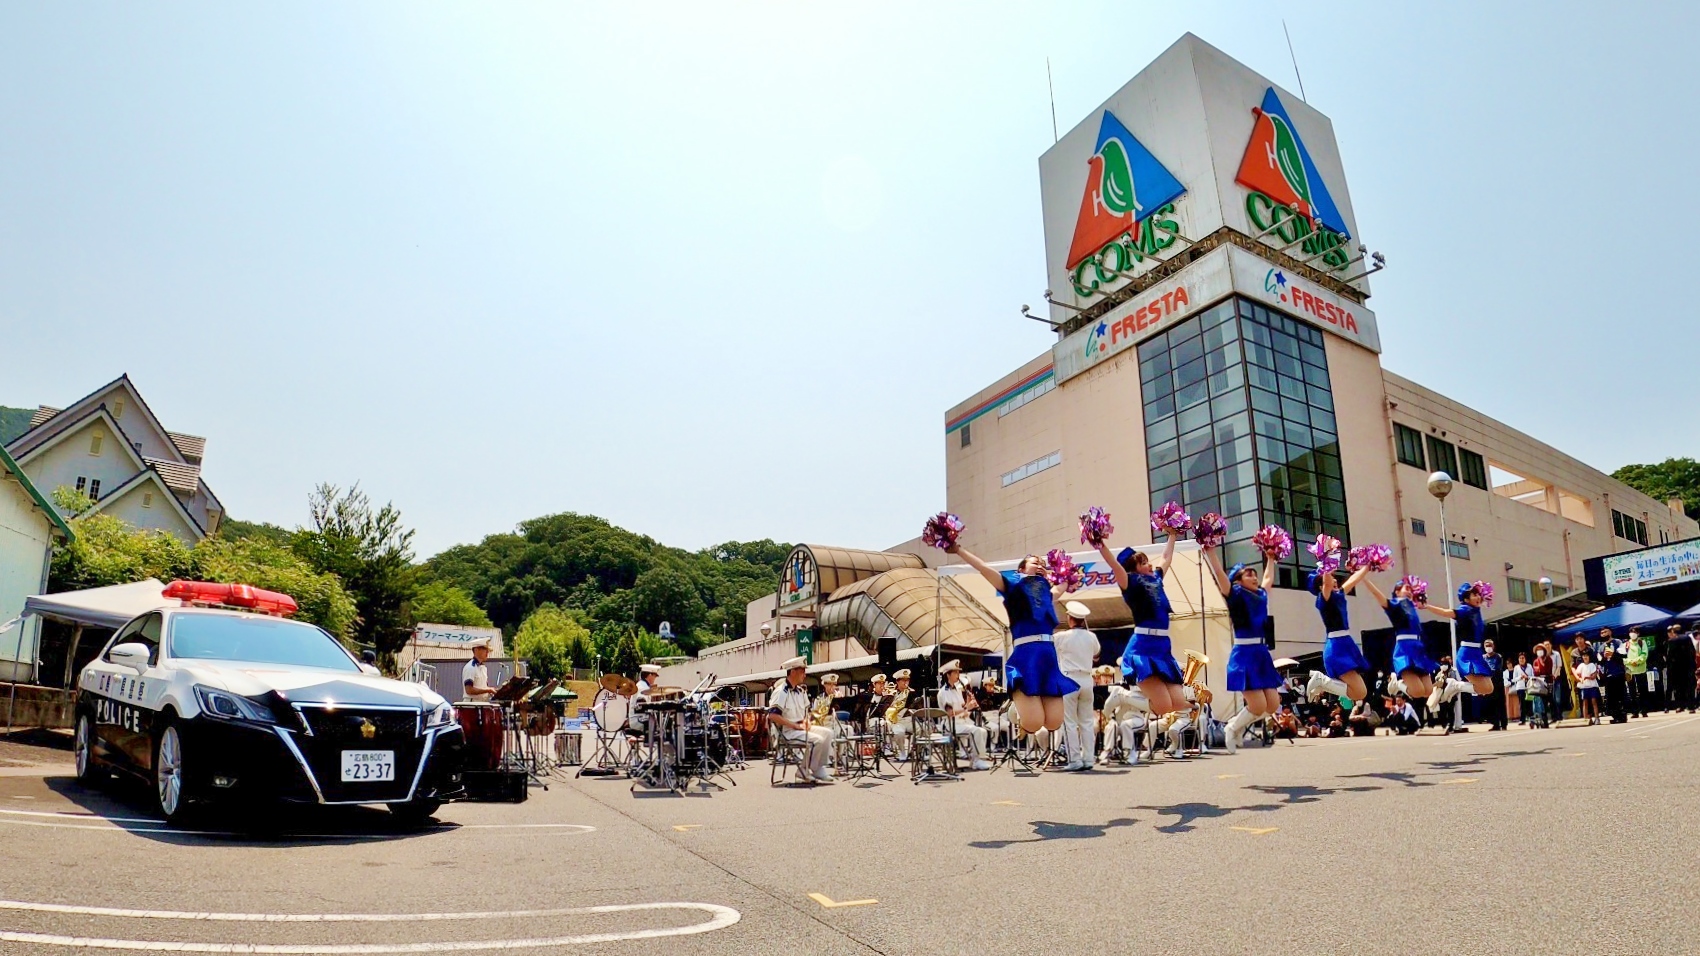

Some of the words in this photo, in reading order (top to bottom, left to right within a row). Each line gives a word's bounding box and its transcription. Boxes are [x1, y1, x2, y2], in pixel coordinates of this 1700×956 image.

[1073, 203, 1179, 297] COMS
[1246, 191, 1350, 271] COMS
[1111, 286, 1188, 345] FRESTA
[1291, 285, 1358, 334] FRESTA
[1638, 566, 1677, 580] スポーツを
[424, 631, 493, 642] ファーマーズシ
[97, 699, 140, 733] POLICE
[353, 763, 391, 779] 23-37
